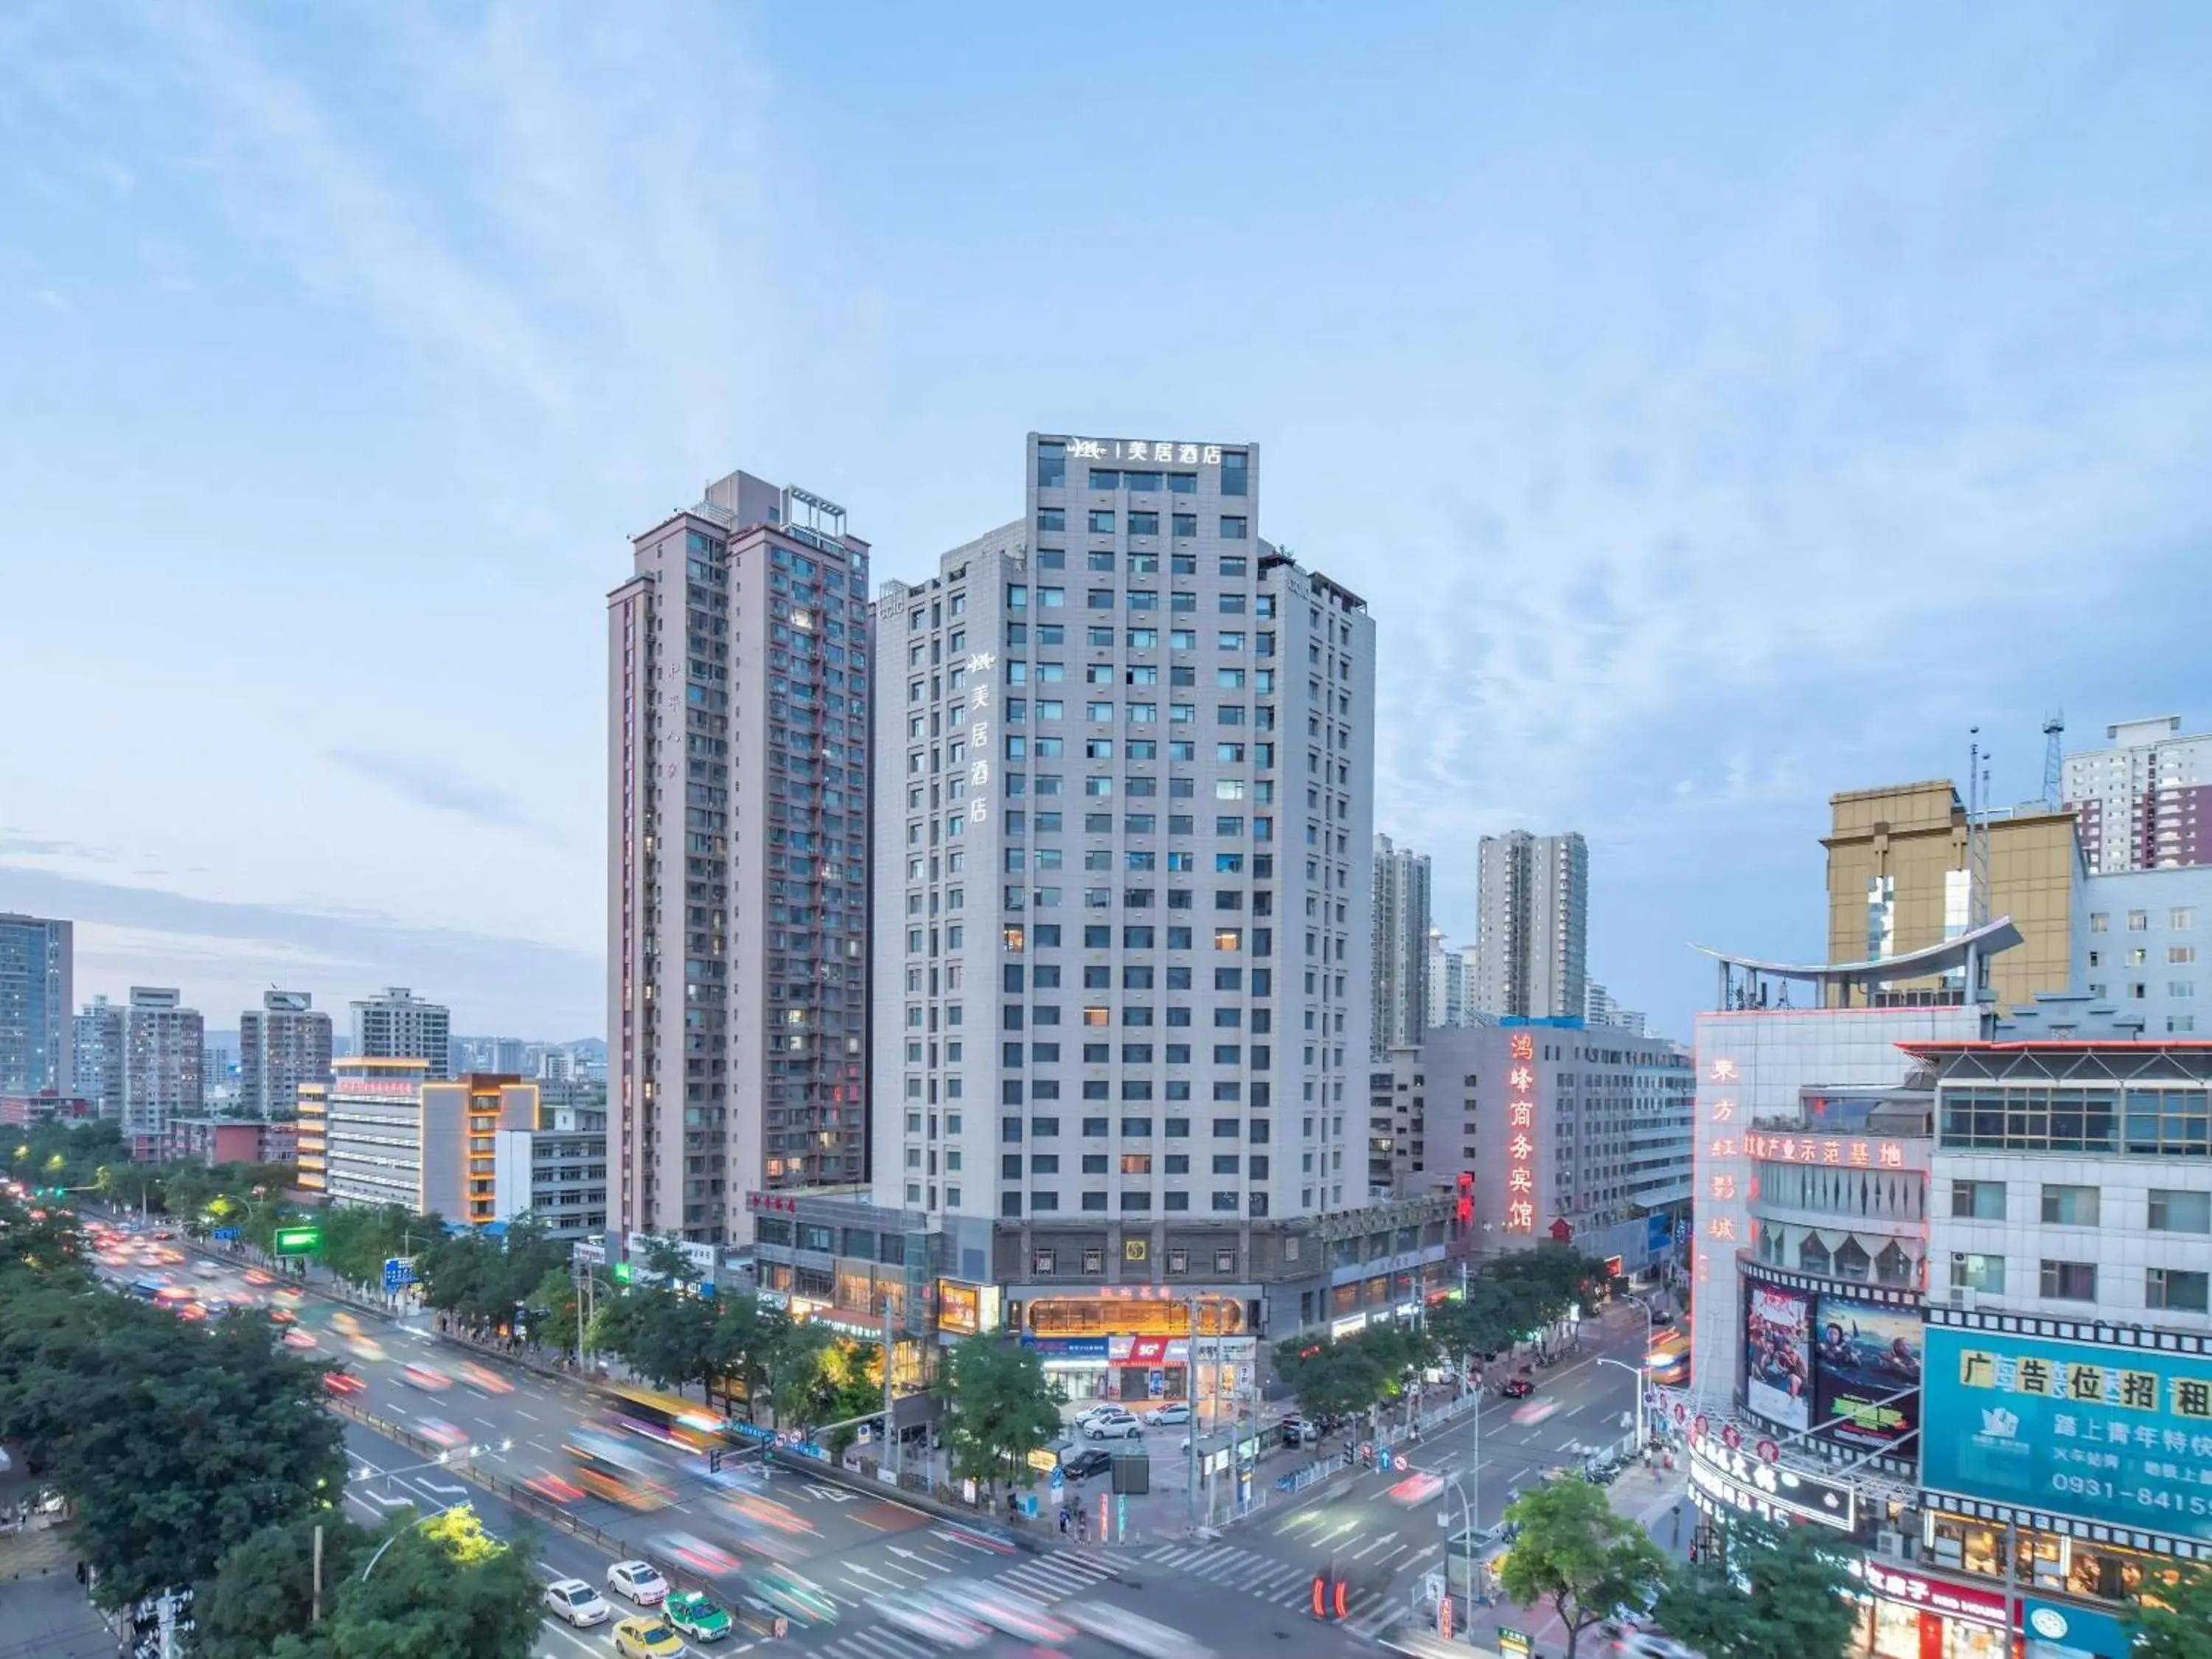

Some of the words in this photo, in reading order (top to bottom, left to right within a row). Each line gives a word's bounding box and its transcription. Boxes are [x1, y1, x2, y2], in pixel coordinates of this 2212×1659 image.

[1128, 441, 1222, 464] 美居酒店
[970, 684, 990, 824] 美居酒店
[1964, 1352, 2211, 1416] 广告位招租
